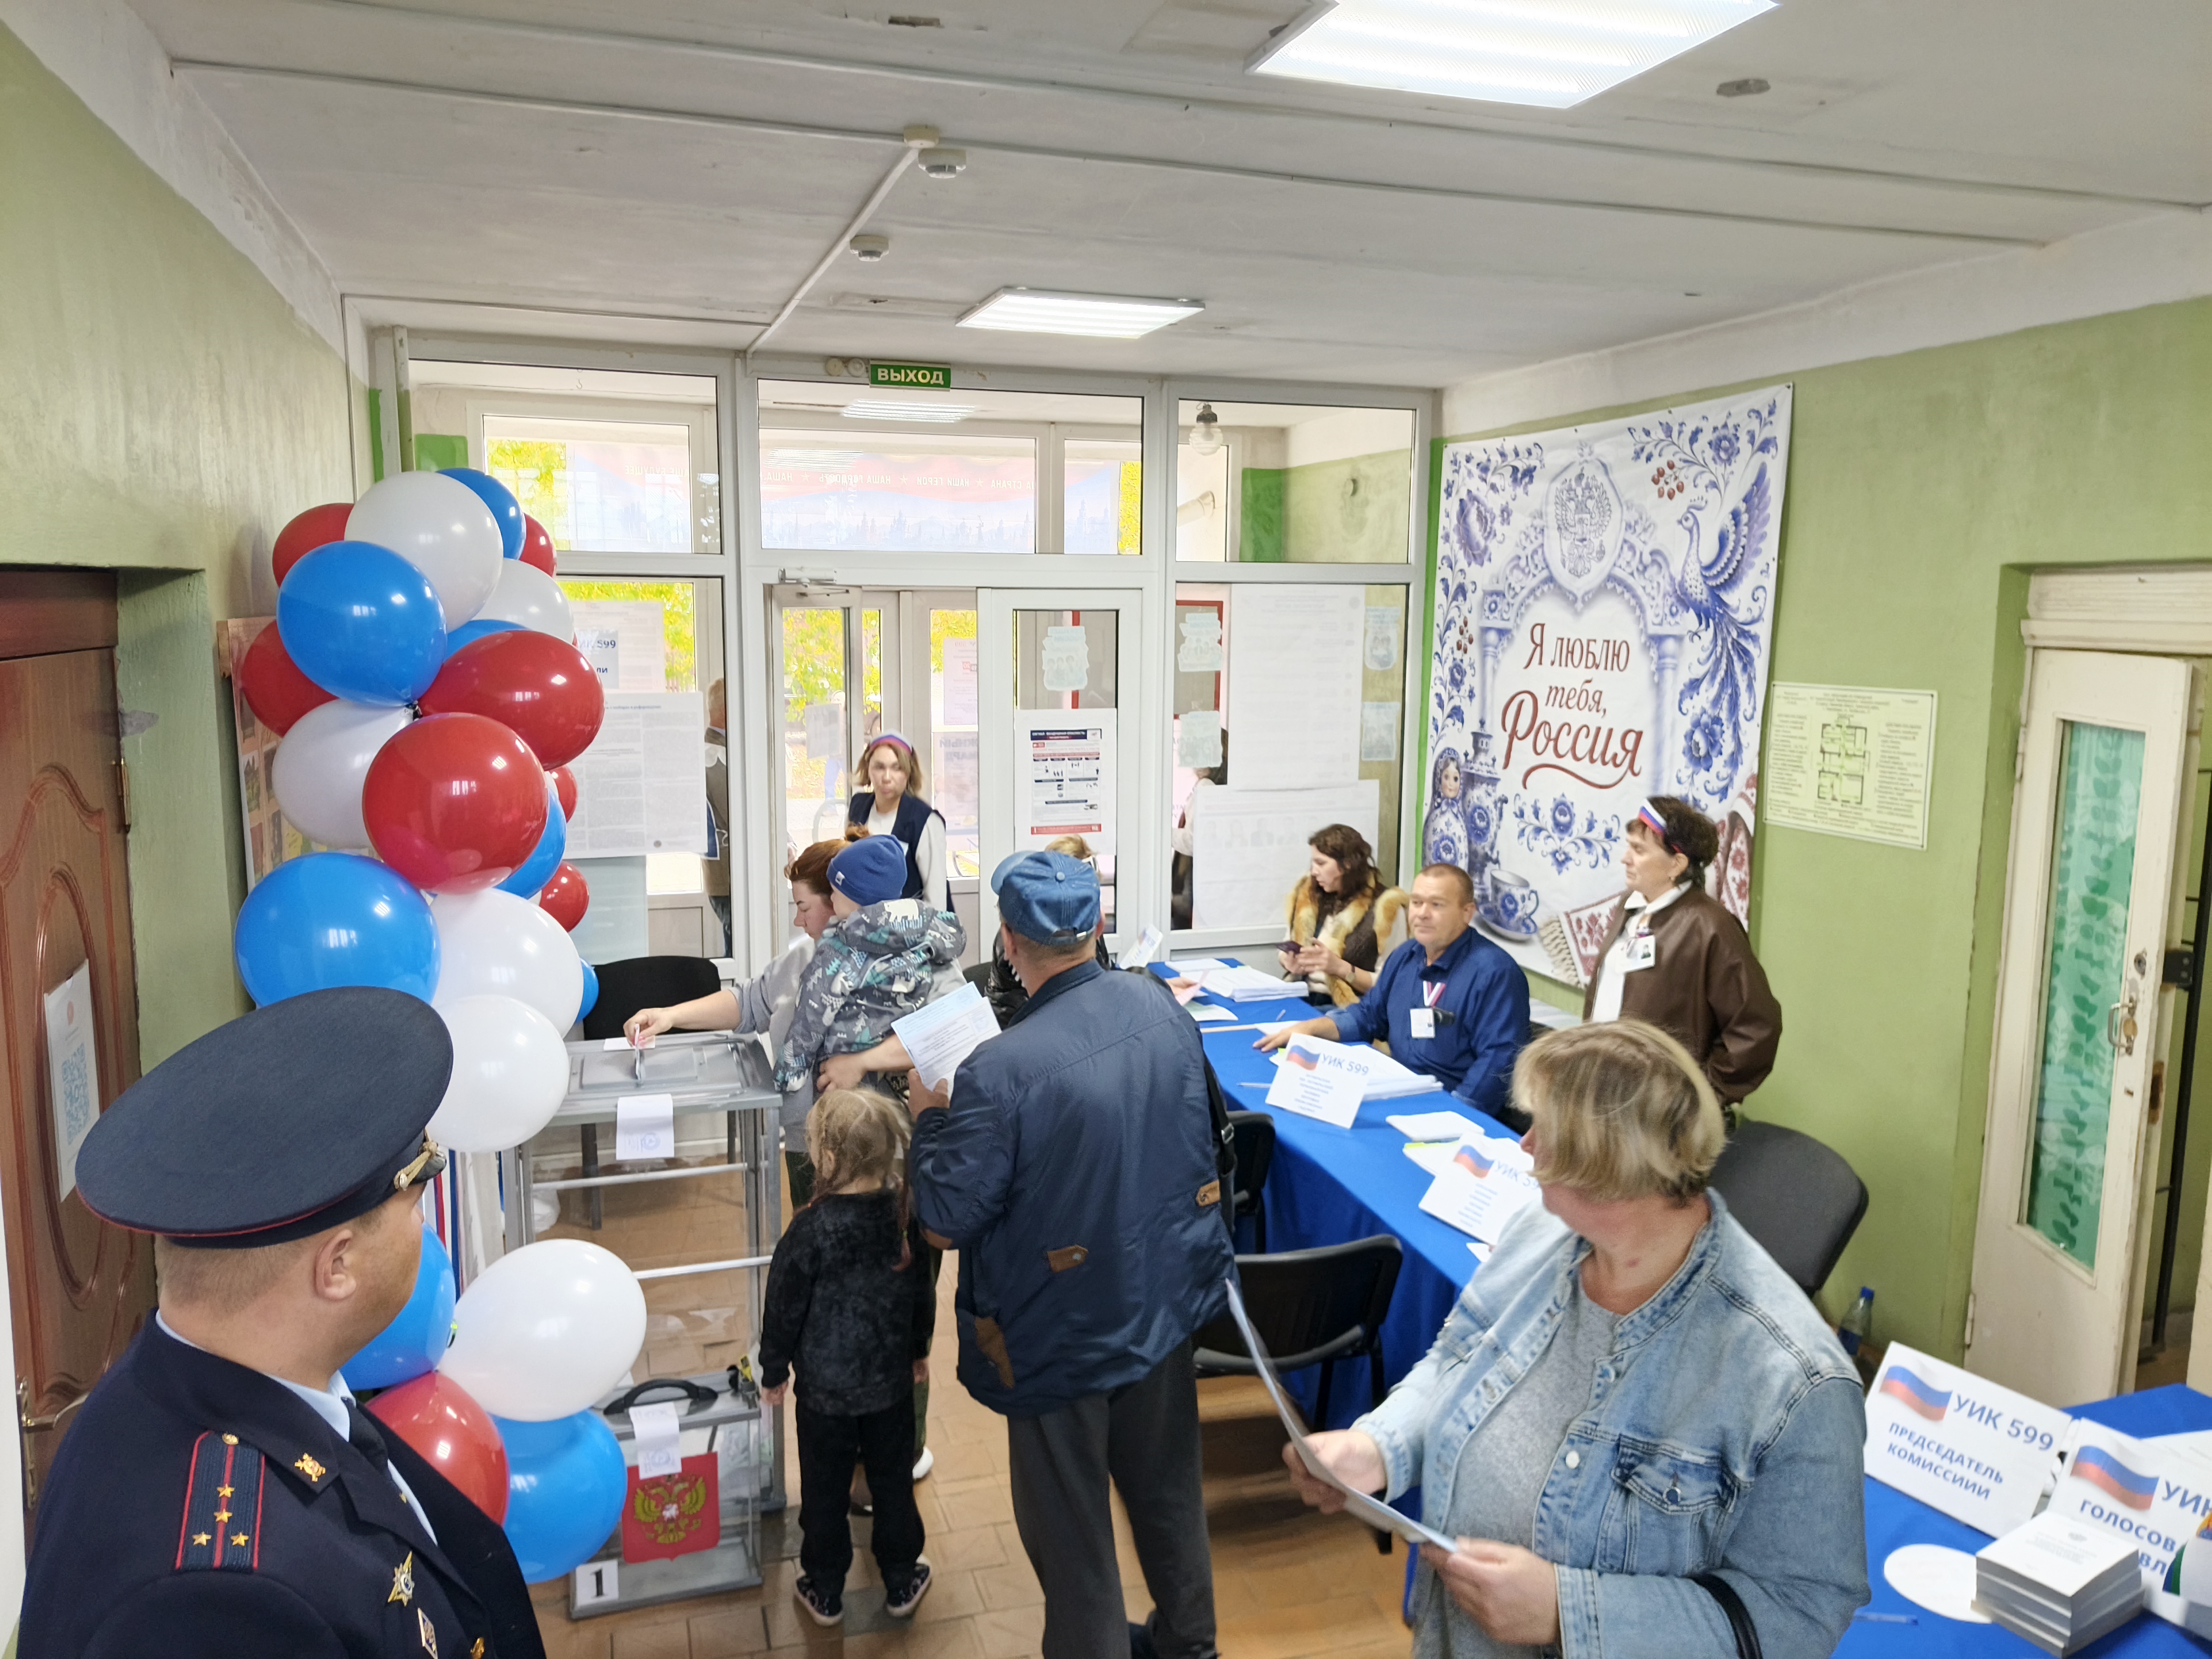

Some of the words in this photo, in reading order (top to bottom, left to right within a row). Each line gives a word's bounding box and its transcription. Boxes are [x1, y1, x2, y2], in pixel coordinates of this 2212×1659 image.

[878, 368, 944, 385] ВЫХОД
[597, 639, 616, 649] 599
[1523, 623, 1545, 669] Я
[1545, 677, 1607, 718] тебя,
[1501, 690, 1644, 779] Россия
[1322, 1053, 1345, 1069] УИК
[1346, 1061, 1369, 1076] 599
[1495, 1161, 1521, 1182] УИК
[1523, 1177, 1540, 1190] 59
[1953, 1393, 2004, 1430] УИК
[2007, 1418, 2054, 1451] 599
[1887, 1443, 1992, 1500] КОМИССИИИ
[1888, 1422, 2004, 1484] ПРЕДСЕДАТЕЛЬ
[2080, 1499, 2176, 1552] ГОЛОСОВ
[590, 1568, 607, 1598] 1
